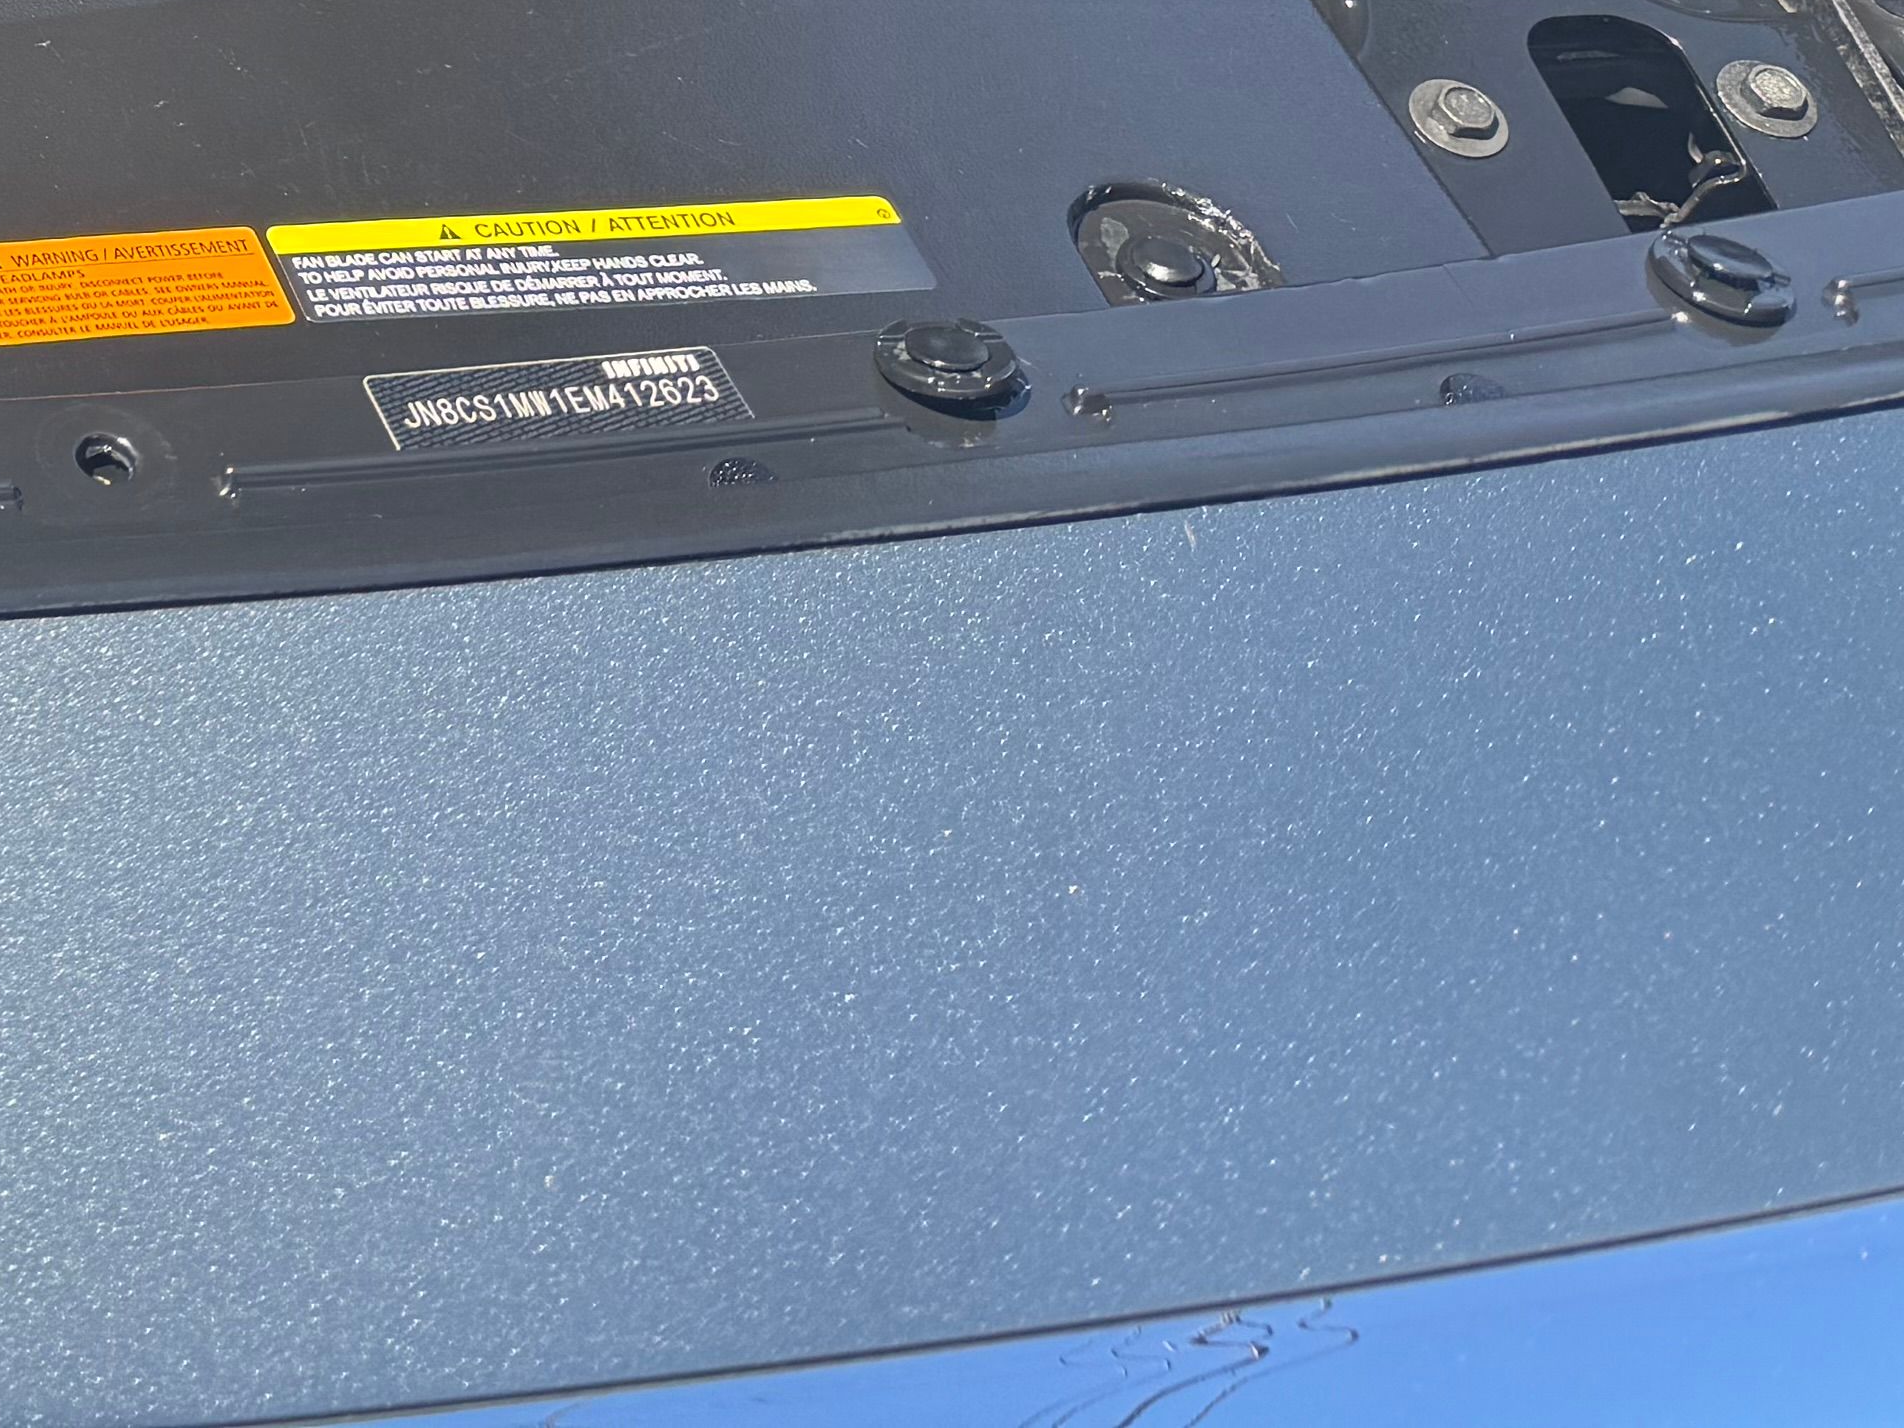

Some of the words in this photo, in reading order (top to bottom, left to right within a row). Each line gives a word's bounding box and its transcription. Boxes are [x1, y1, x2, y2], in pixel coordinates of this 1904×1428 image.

[474, 219, 581, 238] CAUTION
[609, 212, 736, 232] ATTENTION
[10, 249, 99, 268] WARNING
[114, 239, 248, 260] AVERTISSEMENT
[292, 256, 325, 269] FAN
[324, 253, 378, 268] BLADE
[378, 251, 414, 265] CAN
[414, 249, 462, 263] START
[465, 247, 482, 261] AT
[486, 246, 516, 260] ANY
[517, 245, 560, 258] TIME.
[298, 271, 323, 284] TO
[323, 269, 365, 283] HELP
[368, 266, 415, 281] AVOID
[415, 263, 500, 279] PERSONAL
[592, 255, 649, 269] HANDS
[648, 253, 705, 267] CLEAR.
[306, 288, 329, 302] LE
[328, 283, 429, 301] VENTILATEUR
[429, 280, 490, 295] RISQUE
[490, 279, 515, 292] DE
[514, 275, 601, 291] DÉMARRER
[599, 271, 614, 287] À
[613, 272, 655, 286] TOUT
[655, 269, 728, 284] MOMENT.
[314, 302, 362, 317] POUR
[362, 299, 417, 315] ÉVITER
[416, 297, 470, 312] TOUTE
[469, 293, 555, 309] BLESSURE,
[554, 291, 579, 305] NE
[578, 289, 611, 304] PAS
[611, 289, 636, 302] EN
[637, 284, 732, 301] APPROCHER
[732, 282, 763, 296] LES
[762, 279, 818, 295] MAINS.
[602, 353, 700, 379] INFINITI
[404, 374, 720, 429] JN8CS1MW1EM412623
